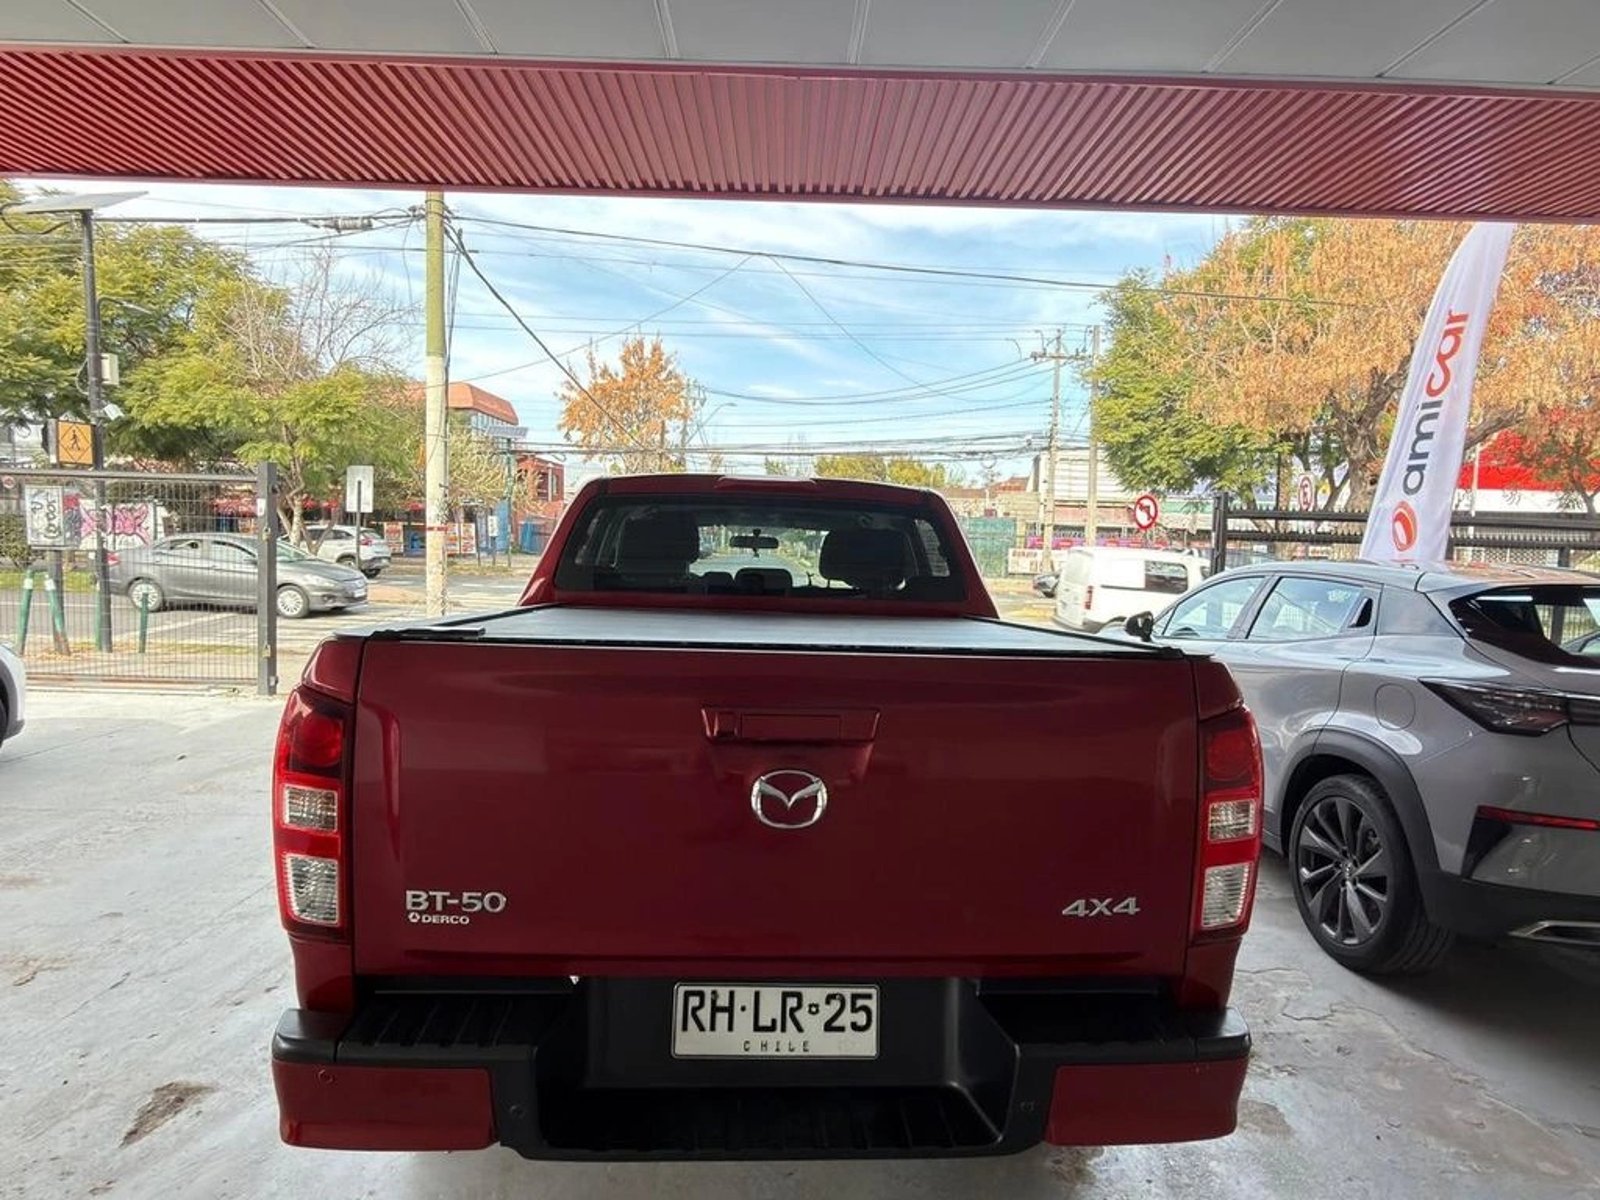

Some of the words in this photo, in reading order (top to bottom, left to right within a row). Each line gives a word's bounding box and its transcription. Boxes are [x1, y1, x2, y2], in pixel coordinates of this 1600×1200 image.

[1402, 309, 1469, 496] amicar
[405, 890, 507, 913] BT-50
[1062, 896, 1141, 917] 4X4
[421, 914, 470, 925] DERCO
[743, 1040, 810, 1053] CHILE
